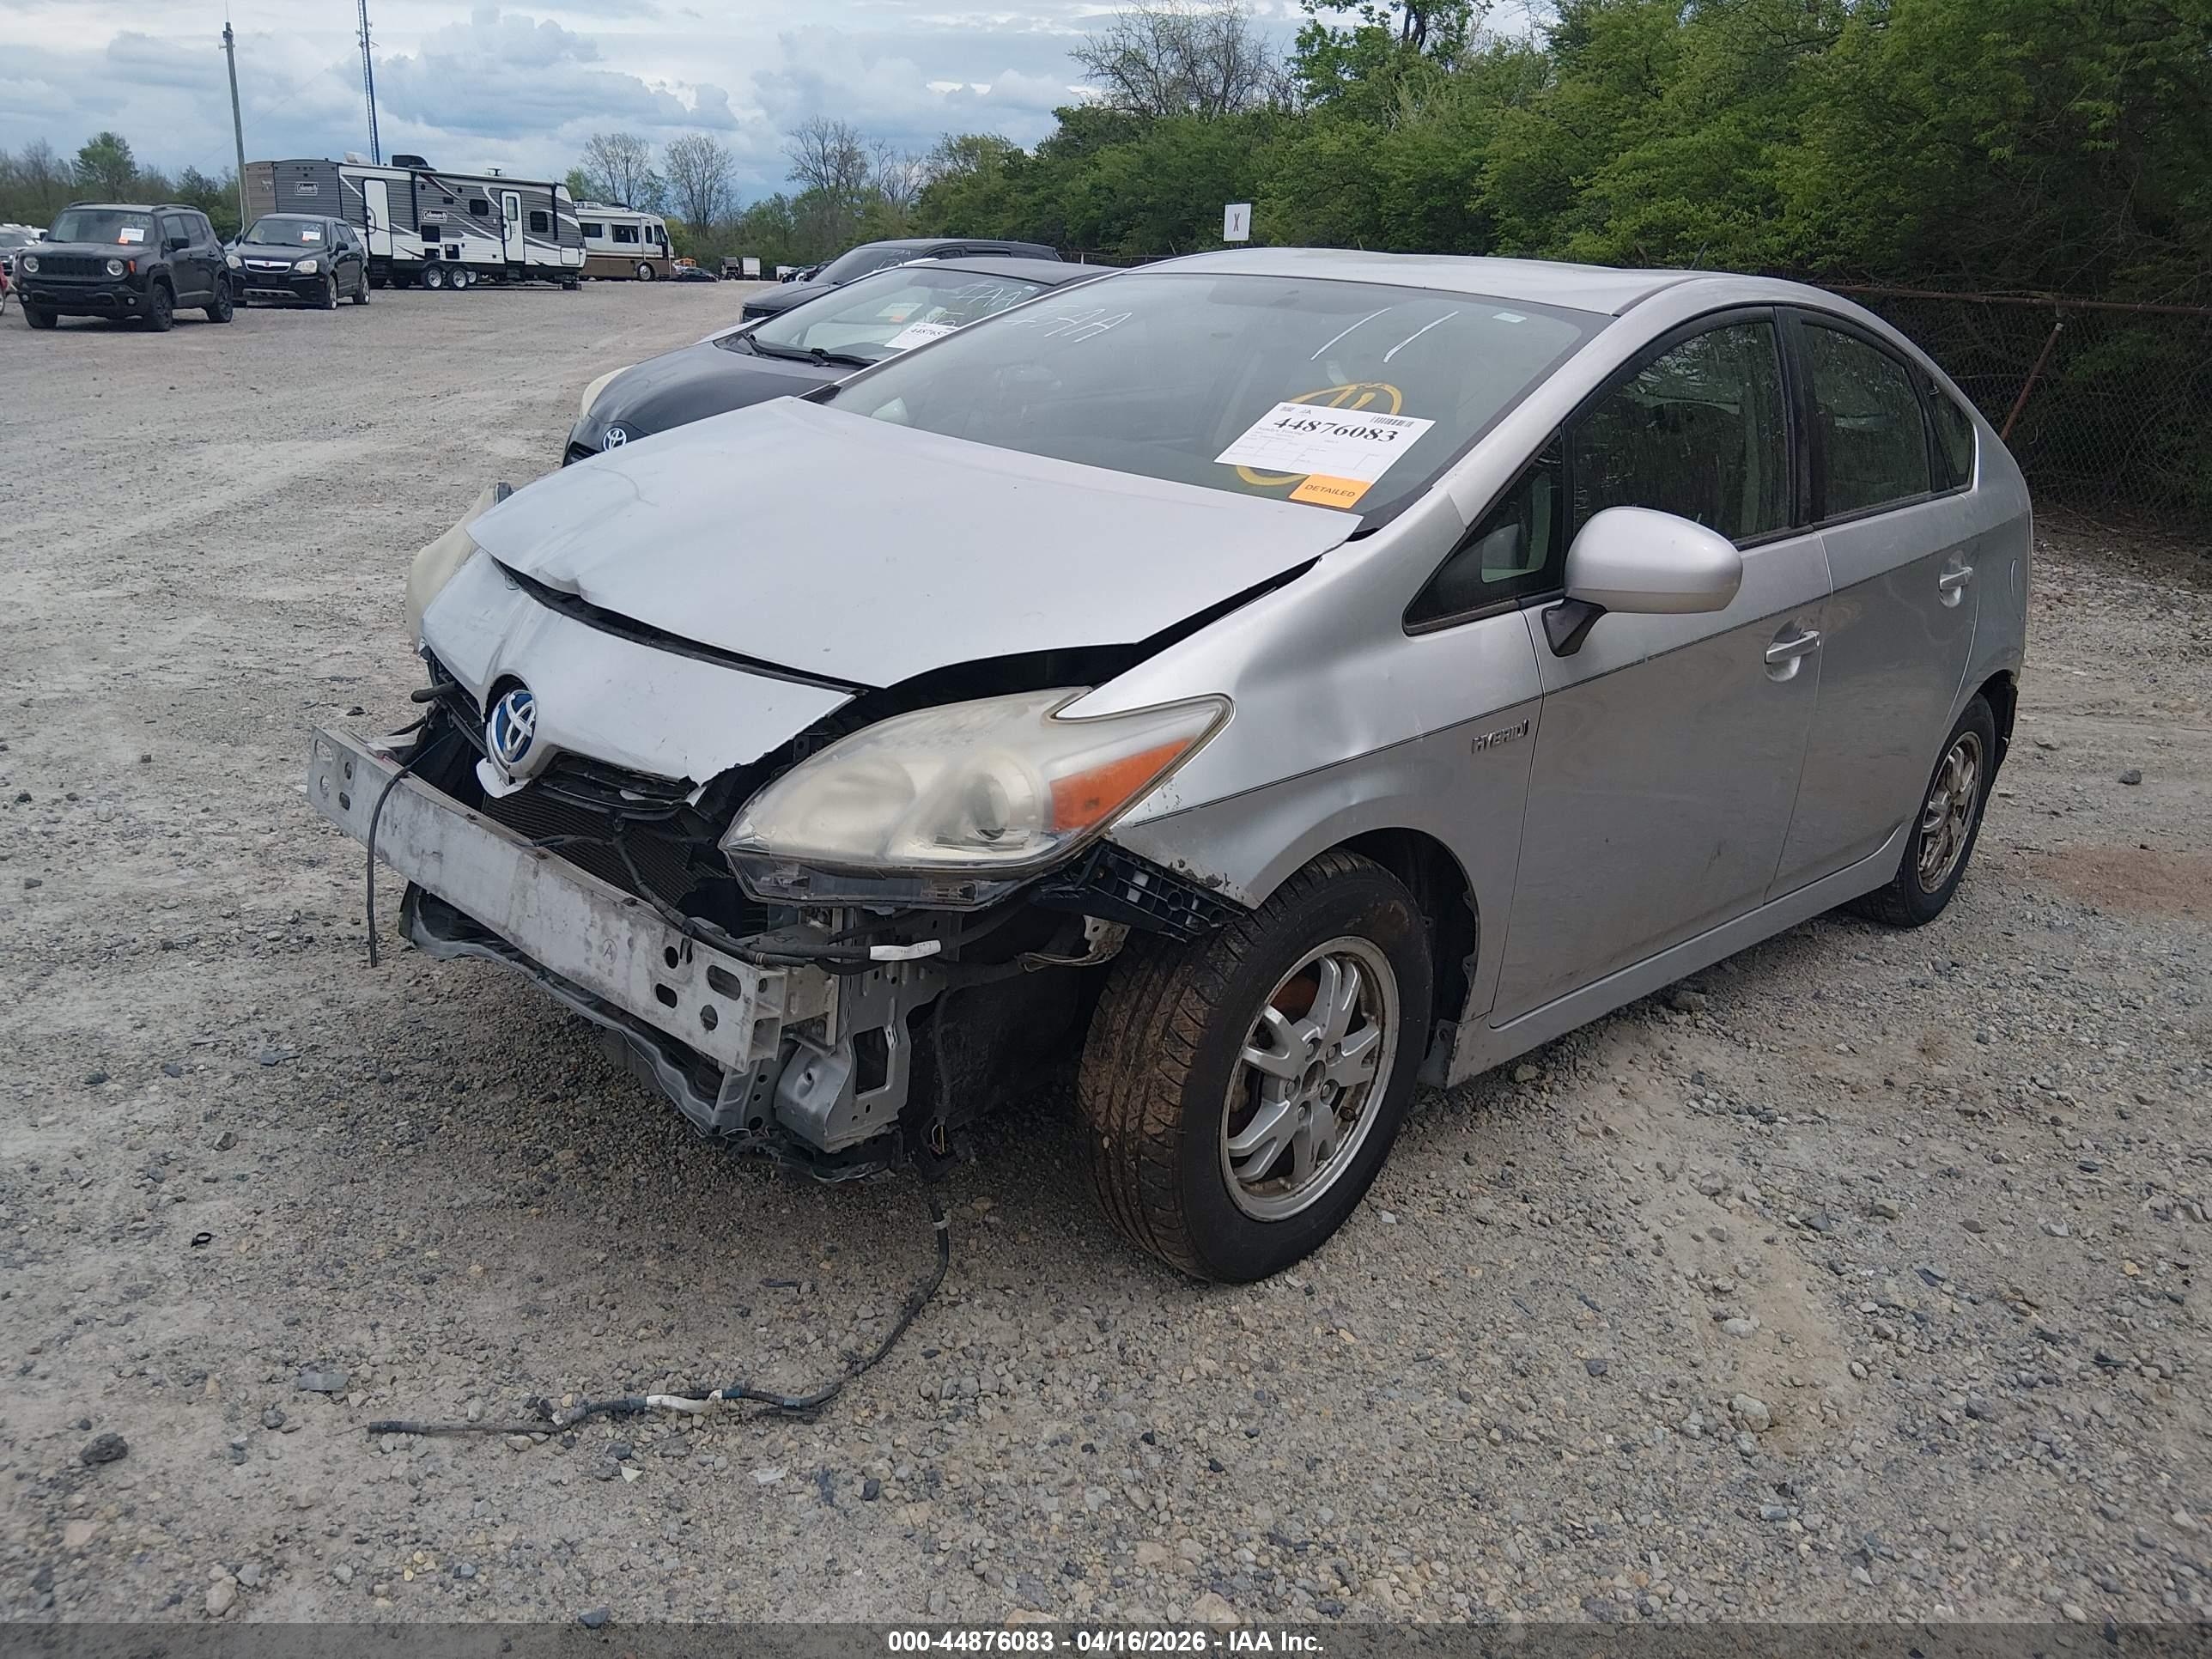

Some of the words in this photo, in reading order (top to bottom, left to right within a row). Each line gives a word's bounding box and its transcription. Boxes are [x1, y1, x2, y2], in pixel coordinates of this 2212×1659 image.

[1233, 212, 1241, 232] X
[951, 283, 1022, 307] IAA
[1003, 305, 1133, 343] IAA
[1273, 417, 1399, 442] 44876083
[1304, 483, 1356, 497] DETAILED
